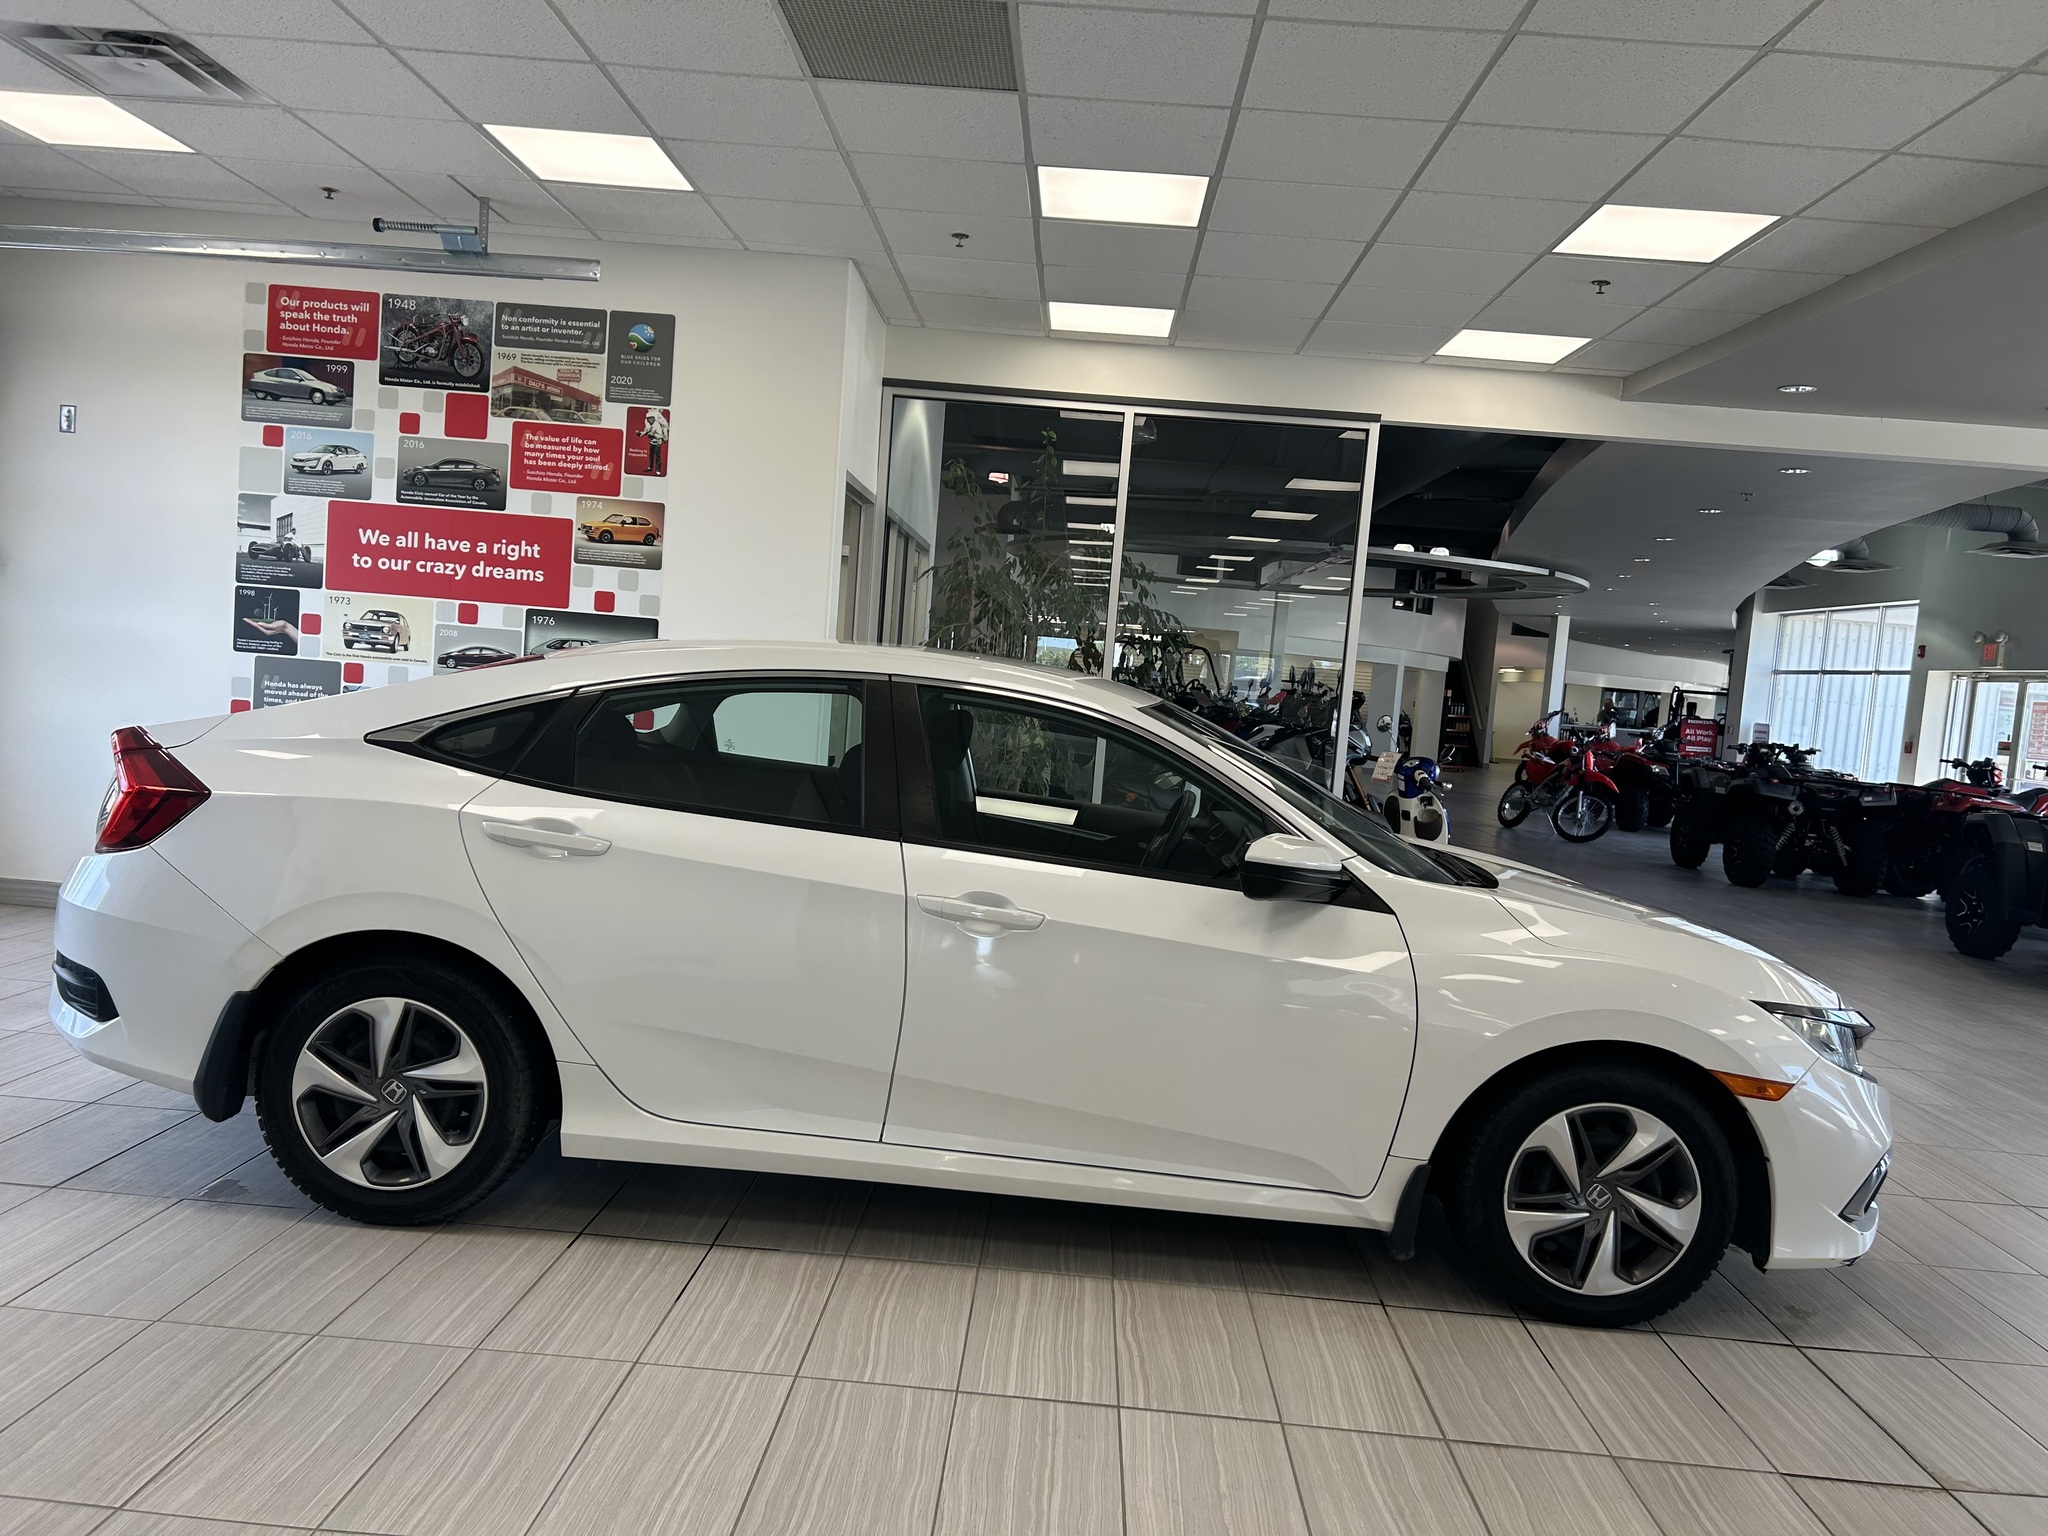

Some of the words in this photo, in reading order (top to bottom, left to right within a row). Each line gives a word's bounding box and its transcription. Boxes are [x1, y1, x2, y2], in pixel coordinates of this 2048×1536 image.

[280, 296, 300, 307] Our
[303, 300, 348, 311] products
[351, 303, 370, 312] will
[388, 298, 416, 311] 1948
[280, 311, 310, 321] speak
[313, 311, 330, 321] the
[332, 314, 358, 324] truth
[501, 314, 518, 322] Non
[518, 316, 559, 326] conformity
[560, 318, 567, 326] is
[568, 319, 600, 328] essential
[279, 321, 310, 332] about
[312, 323, 350, 335] Honda.
[521, 325, 540, 333] artist
[551, 326, 584, 336] inventor.
[326, 364, 348, 374] 1999
[528, 380, 545, 390] DALT'S
[610, 375, 633, 385] 2020
[291, 431, 312, 440] 2016
[525, 433, 539, 441] The
[540, 435, 560, 443] value
[571, 436, 583, 445] life
[403, 439, 425, 449] 2016
[535, 443, 571, 452] measured
[573, 445, 582, 454] by
[584, 446, 600, 454] how
[524, 451, 544, 459] many
[546, 451, 565, 460] times
[567, 454, 584, 463] your
[585, 454, 600, 462] soul
[538, 459, 557, 467] been
[558, 461, 583, 470] deeply
[584, 463, 611, 471] stirred.
[581, 500, 603, 510] 1974
[358, 528, 390, 546] We
[395, 531, 419, 549] all
[424, 532, 471, 553] have
[476, 541, 487, 554] a
[493, 539, 541, 561] right
[352, 553, 372, 568] to
[377, 556, 411, 571] our
[415, 560, 467, 580] crazy
[471, 561, 545, 582] dreams
[239, 589, 256, 597] 1998
[329, 596, 351, 605] 1973
[532, 615, 555, 626] 1976
[439, 629, 458, 637] 2008
[1983, 643, 1998, 660] EXIT
[264, 680, 286, 688] Honda
[300, 682, 323, 691] always
